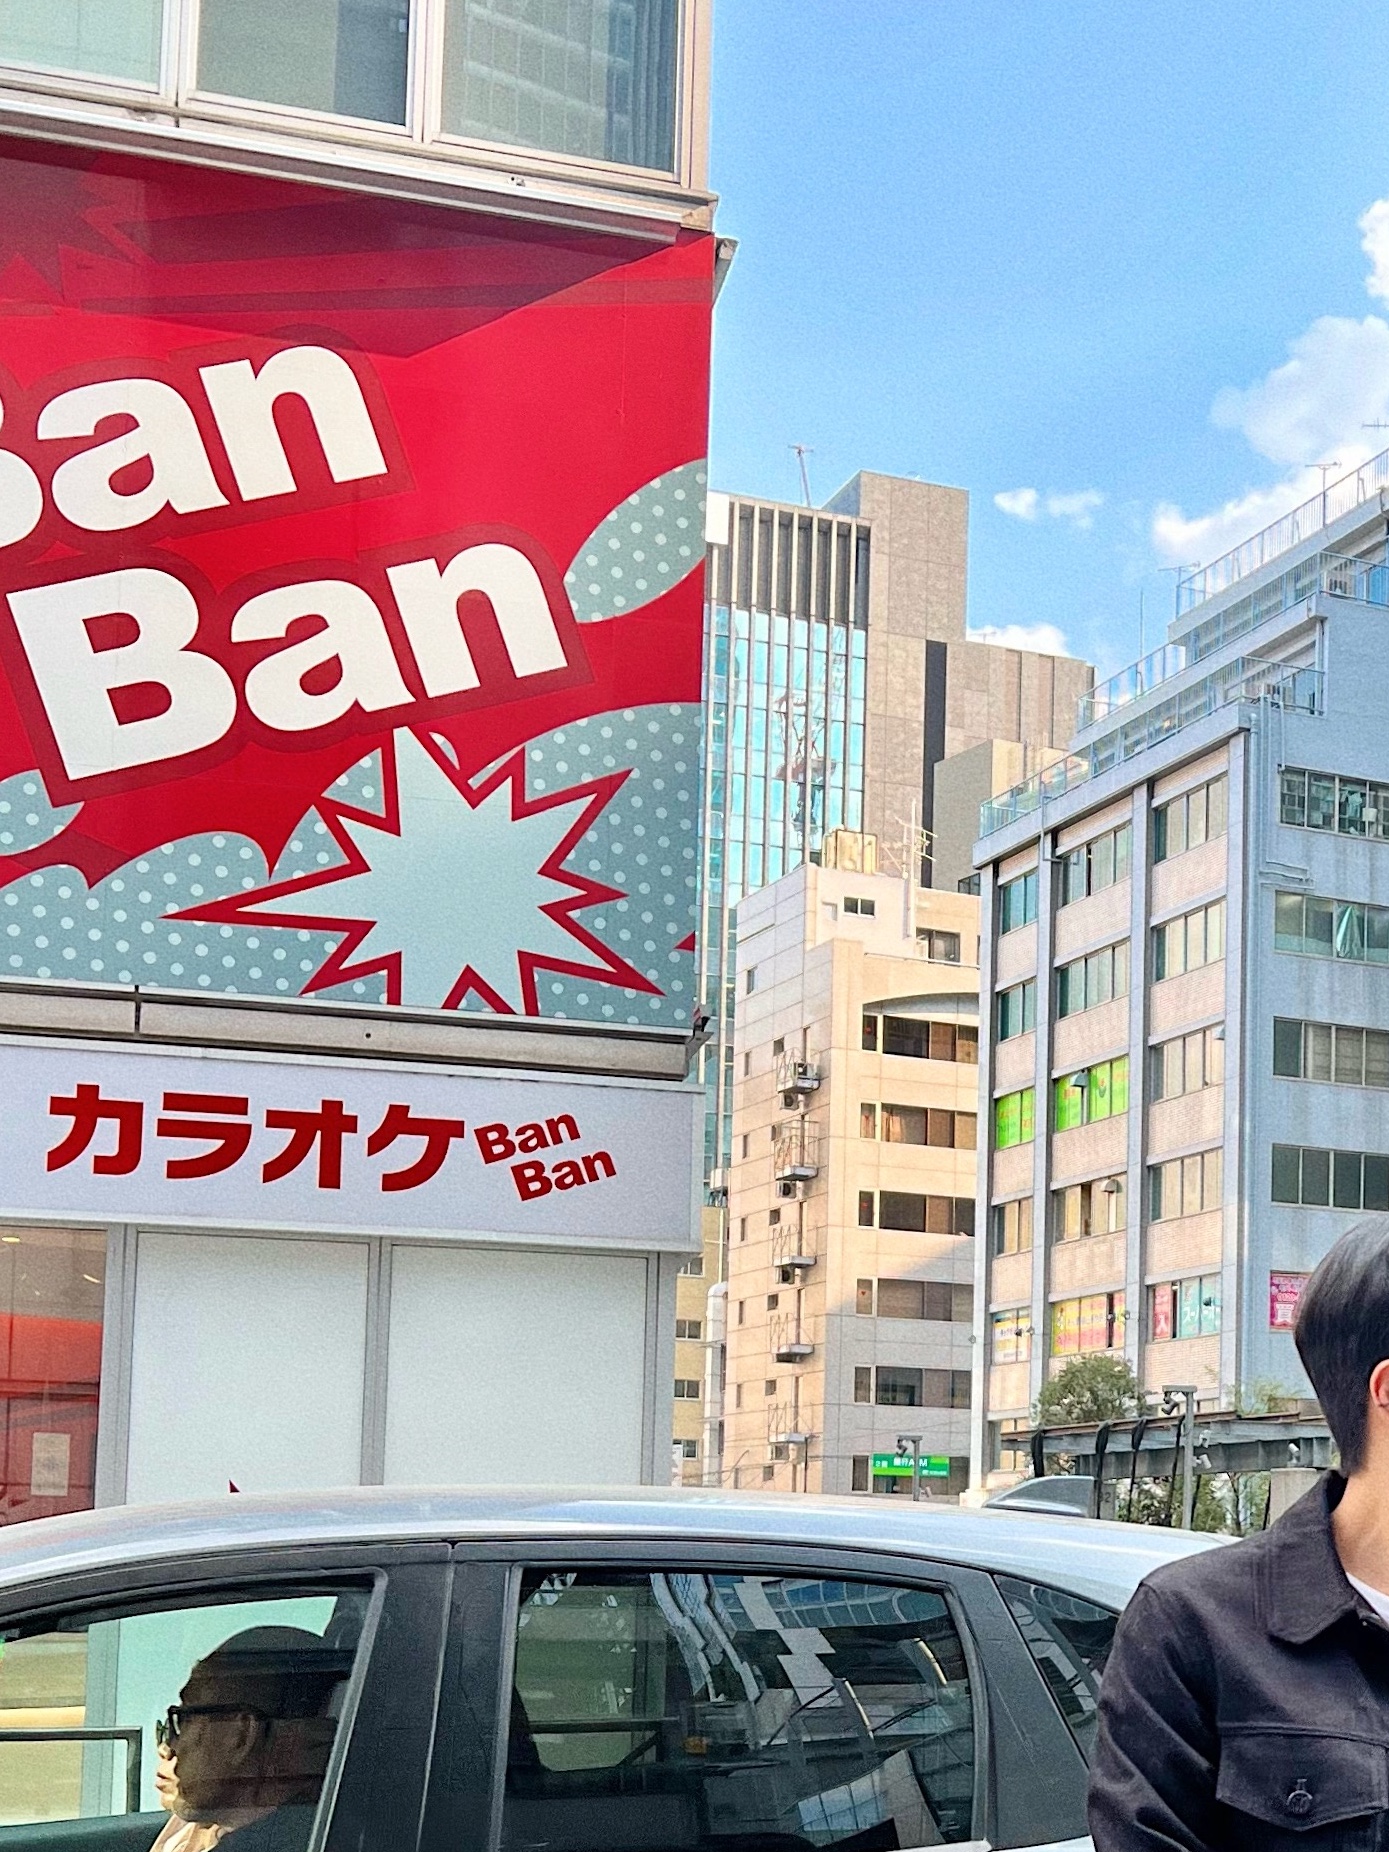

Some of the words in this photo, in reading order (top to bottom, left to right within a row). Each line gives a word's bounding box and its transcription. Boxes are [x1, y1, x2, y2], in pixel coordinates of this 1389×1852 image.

[6, 543, 568, 781] Ban
[46, 1083, 465, 1192] カラオケ
[475, 1114, 580, 1164] Ban
[511, 1151, 615, 1201] Ban
